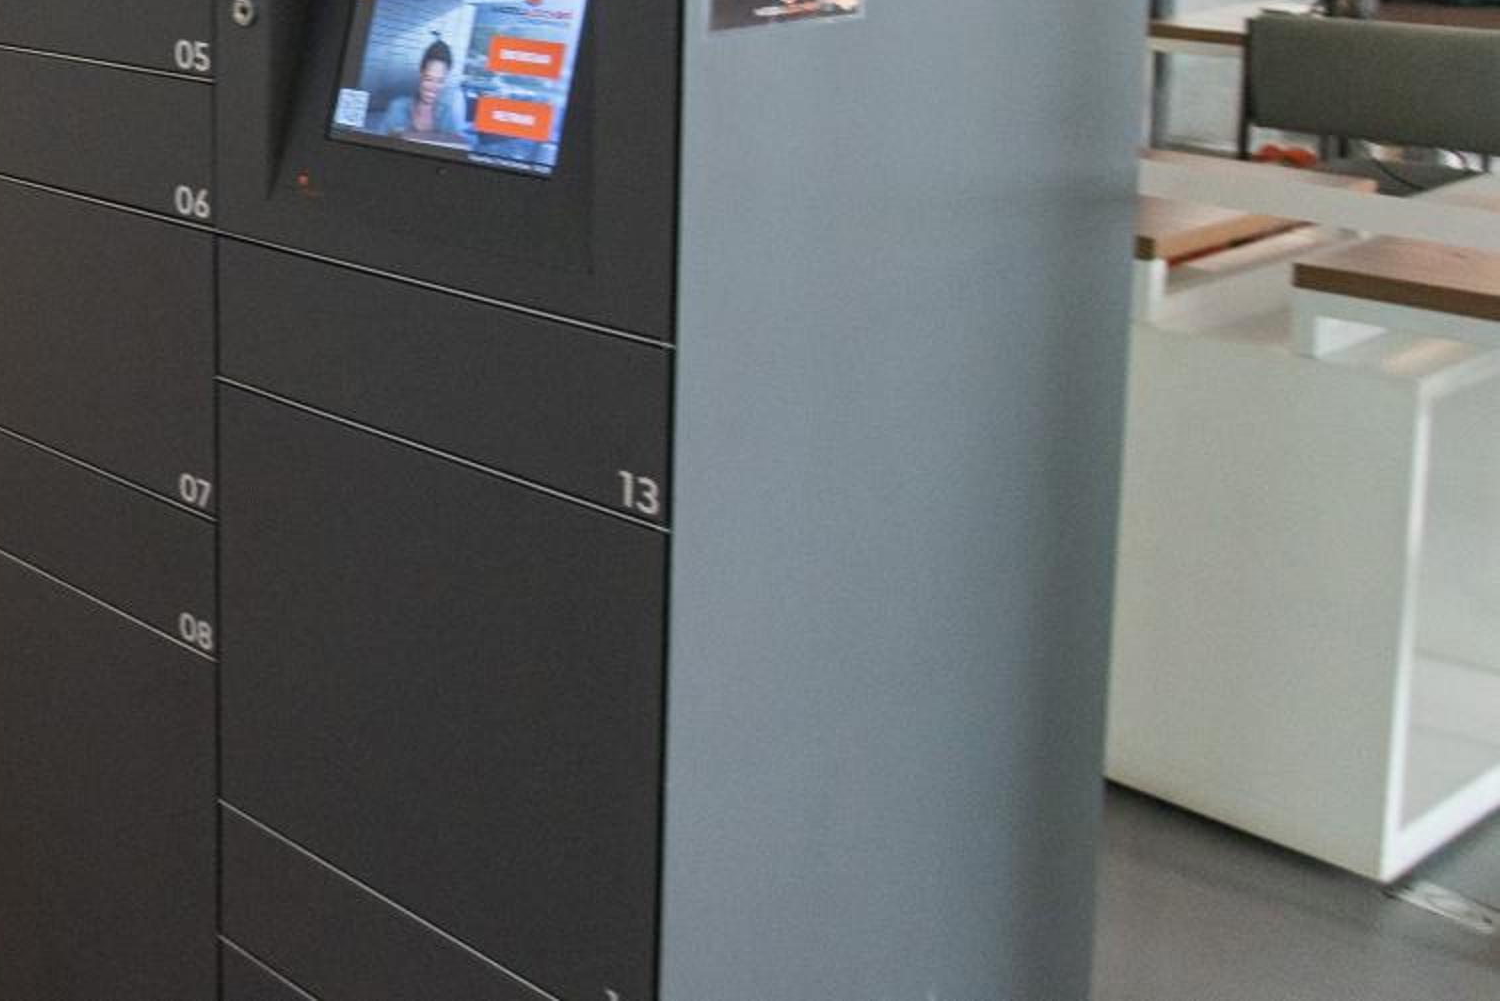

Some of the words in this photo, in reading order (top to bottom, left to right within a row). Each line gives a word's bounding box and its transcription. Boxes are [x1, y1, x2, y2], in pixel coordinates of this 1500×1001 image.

[173, 38, 210, 73] 05
[174, 184, 211, 219] 06
[178, 473, 212, 507] 07
[618, 470, 661, 516] 13
[179, 612, 213, 650] 08
